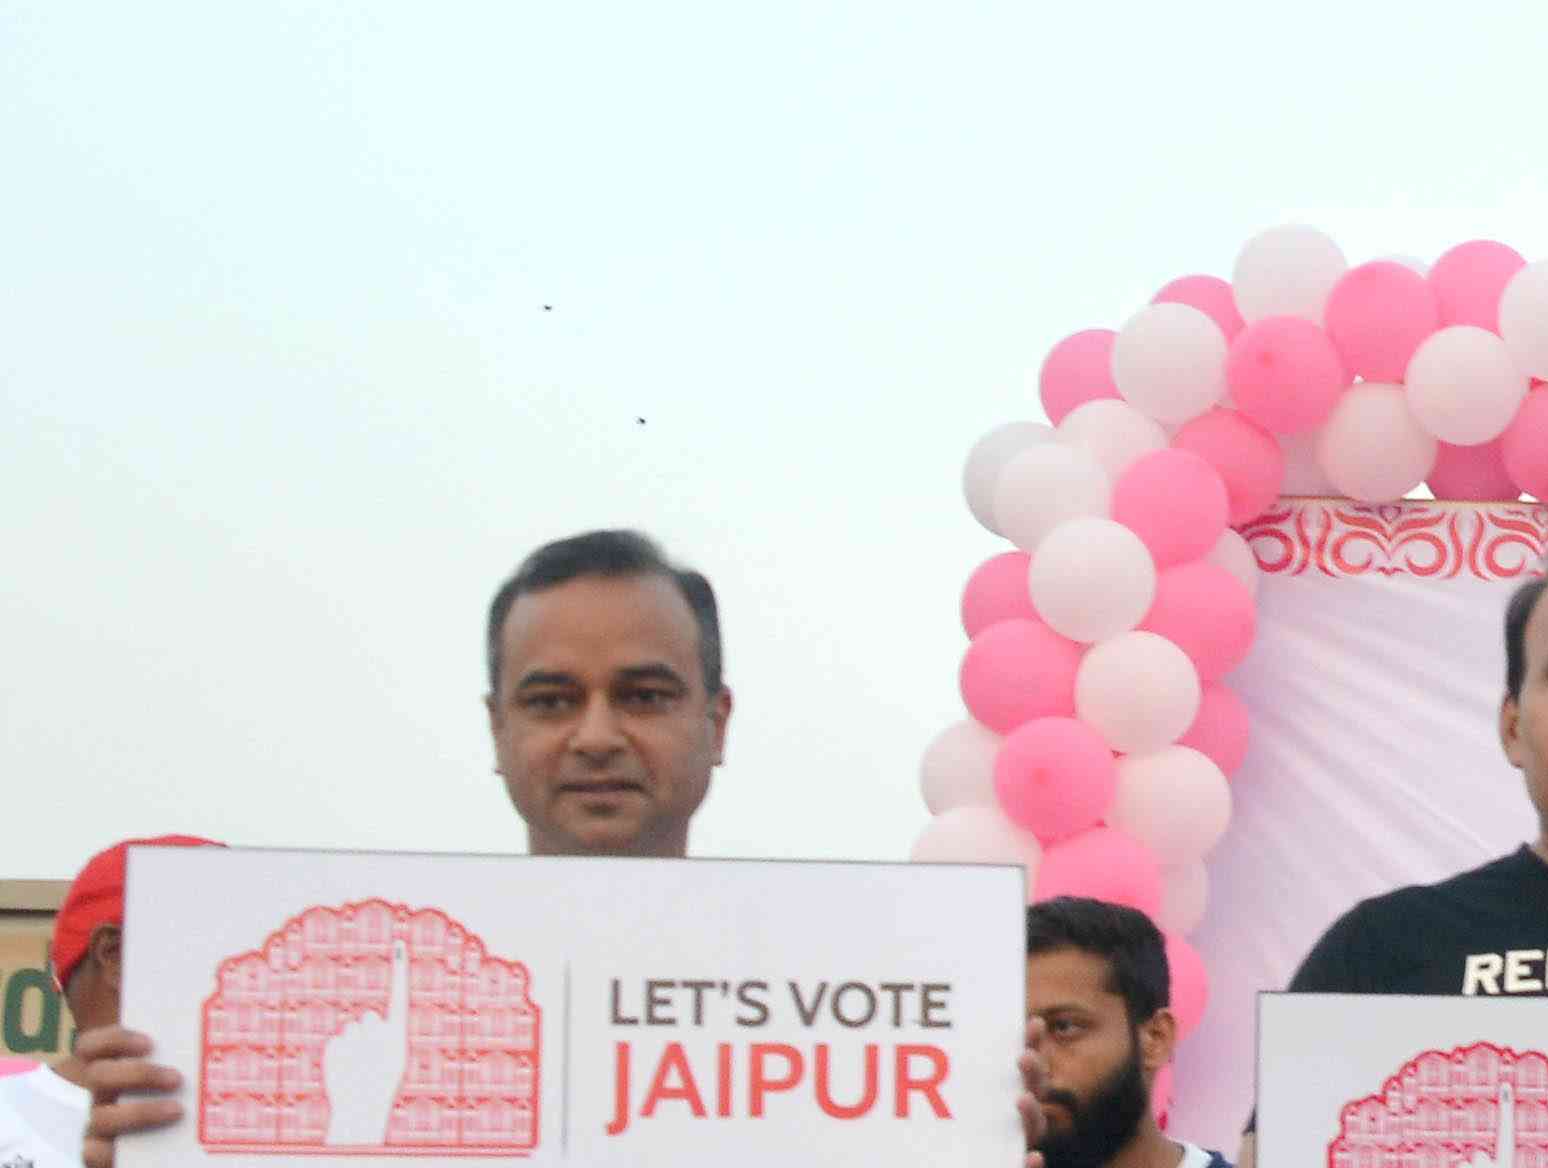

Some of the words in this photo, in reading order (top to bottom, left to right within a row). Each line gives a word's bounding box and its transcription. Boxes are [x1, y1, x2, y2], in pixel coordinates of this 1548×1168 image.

[612, 979, 769, 1027] LET'S
[789, 982, 951, 1028] VOTE
[606, 1041, 952, 1136] JAIPUR
